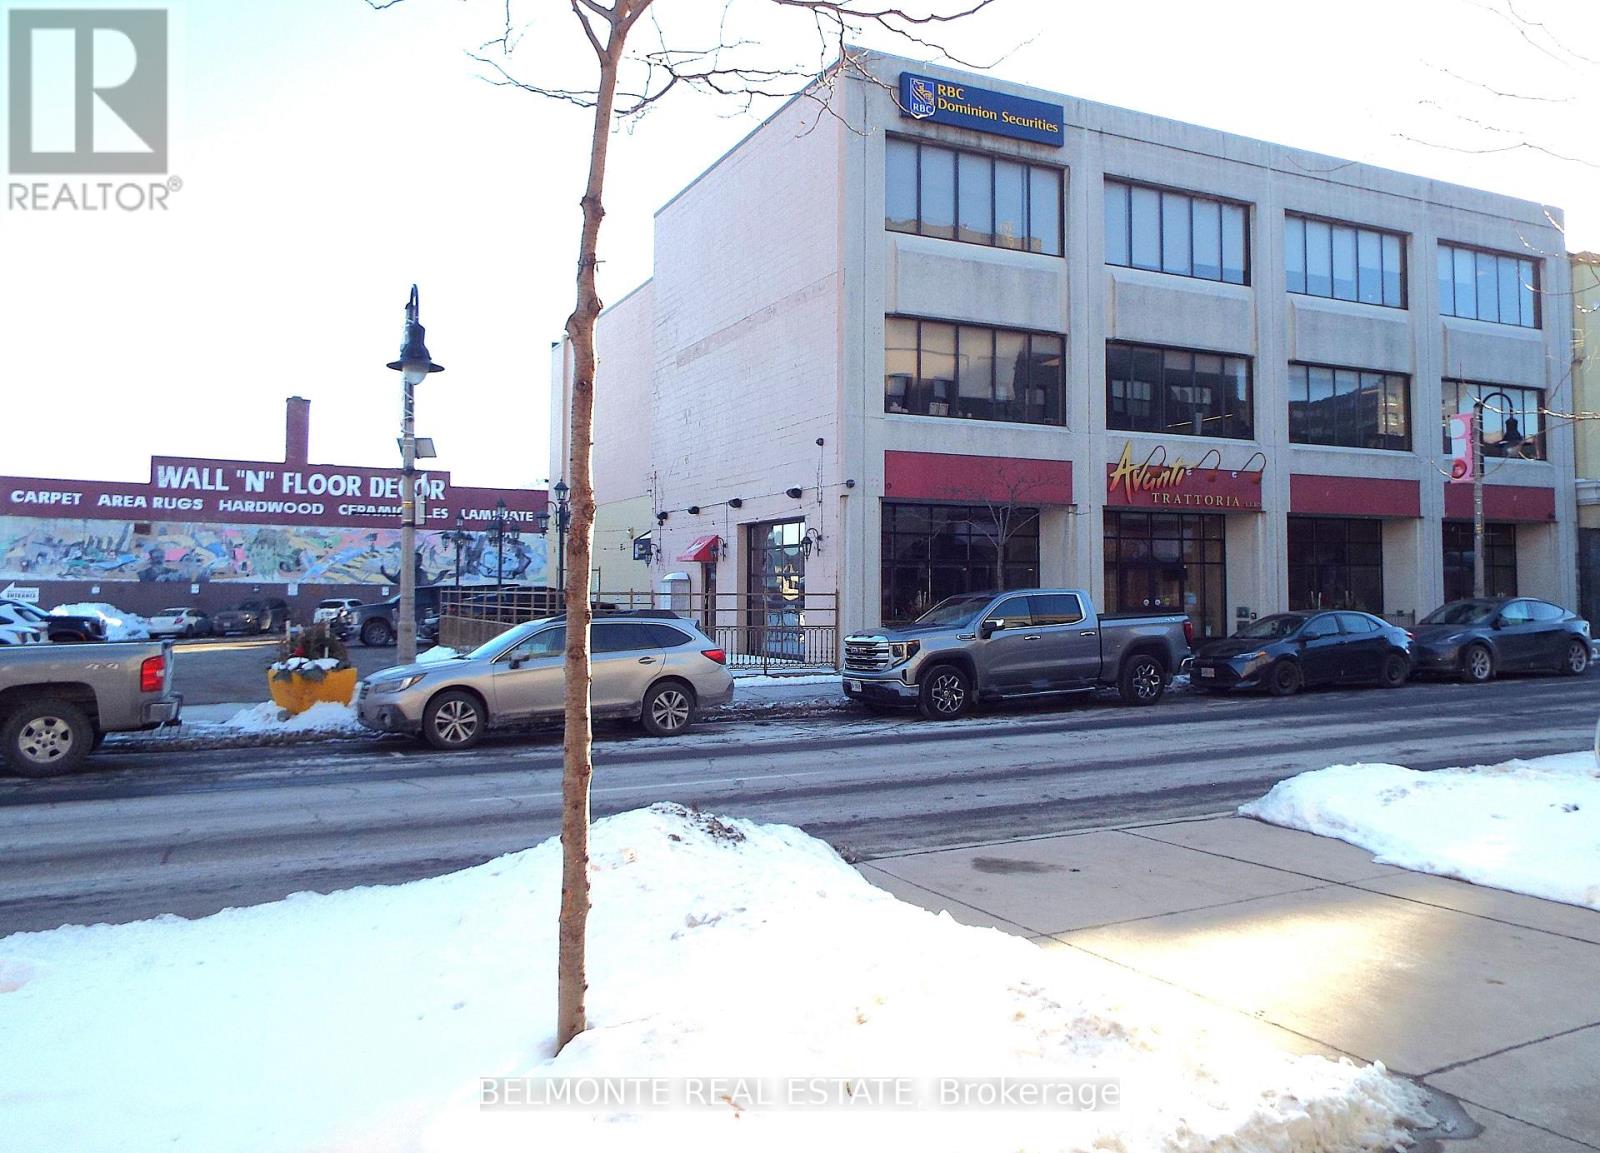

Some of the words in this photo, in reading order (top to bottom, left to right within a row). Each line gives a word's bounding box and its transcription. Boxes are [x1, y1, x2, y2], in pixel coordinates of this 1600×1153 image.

[938, 84, 965, 100] RBC
[913, 102, 932, 114] RBC
[938, 97, 998, 121] Dominion
[1001, 111, 1059, 133] Securities
[157, 465, 229, 491] WALL
[236, 469, 275, 493] "N"
[282, 472, 361, 497] FLOOR
[1109, 439, 1198, 504] Avanti
[11, 490, 83, 505] CARPET
[97, 494, 147, 508] AREA
[152, 497, 204, 511] RUGS
[218, 499, 324, 515] HARDWOOD
[1152, 492, 1240, 507] TRATTORIA
